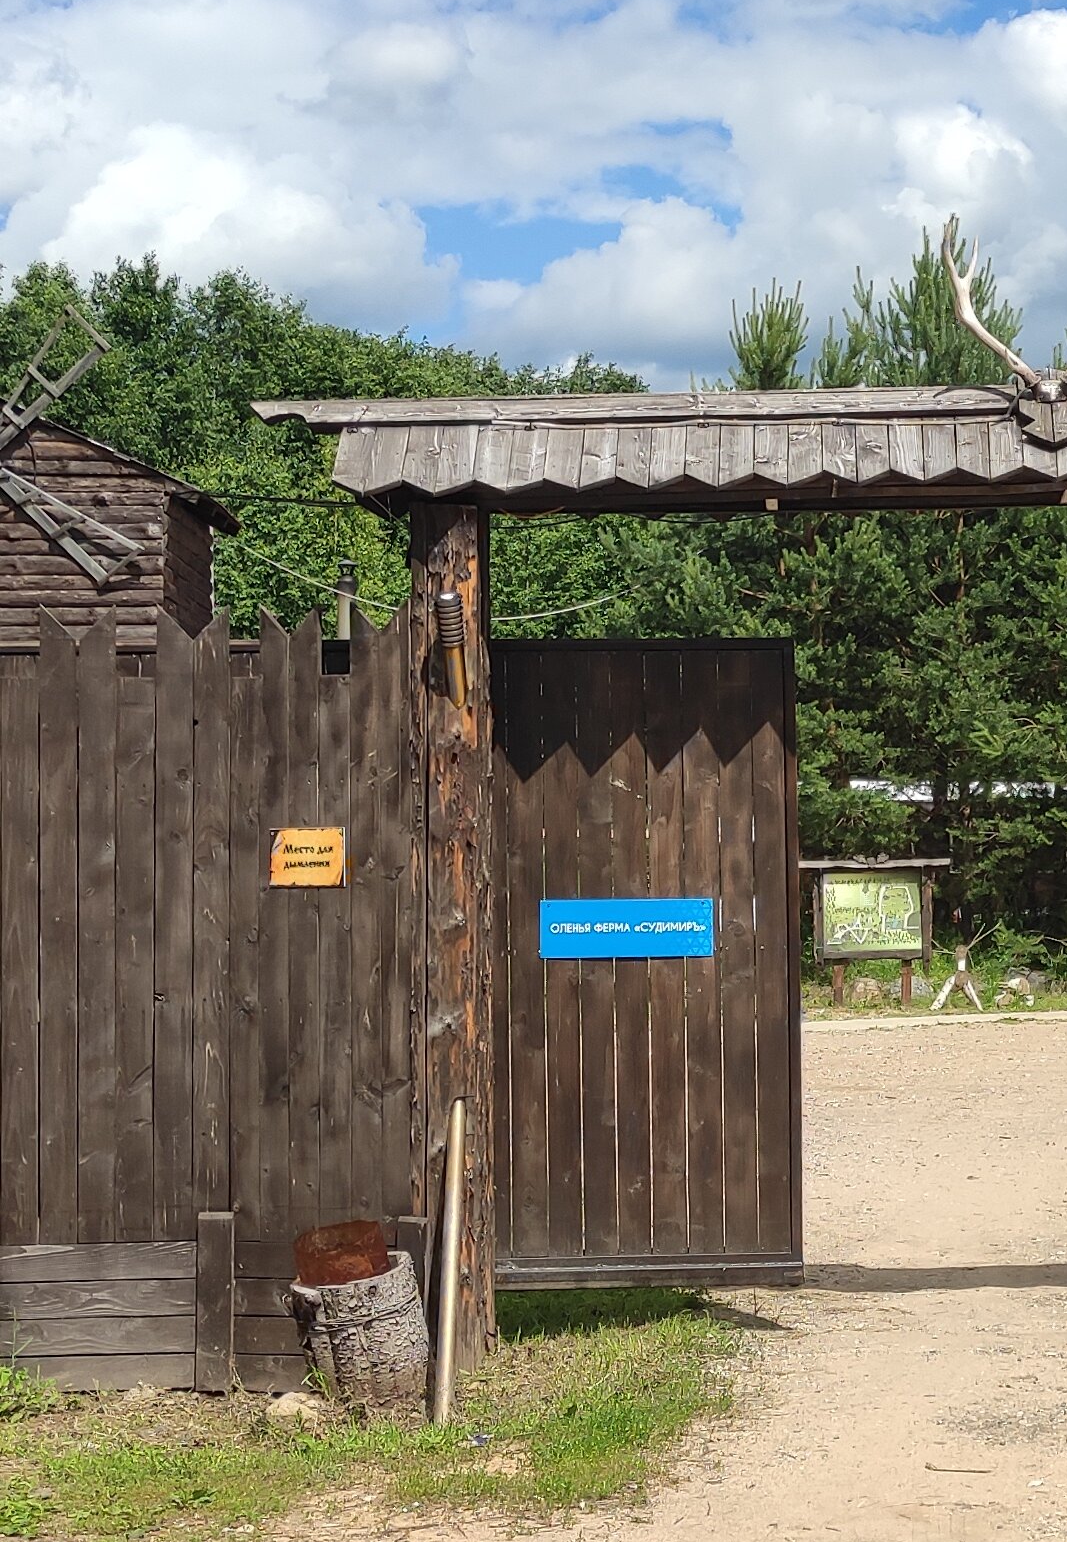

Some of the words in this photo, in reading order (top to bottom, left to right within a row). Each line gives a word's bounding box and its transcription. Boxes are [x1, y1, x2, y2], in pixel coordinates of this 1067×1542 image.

[282, 844, 315, 854] Место
[316, 846, 334, 855] для
[550, 922, 591, 934] ОЛЕНЬЯ
[593, 922, 631, 933] ФЕРМА
[634, 921, 707, 934] «СУДИМИРЪ»
